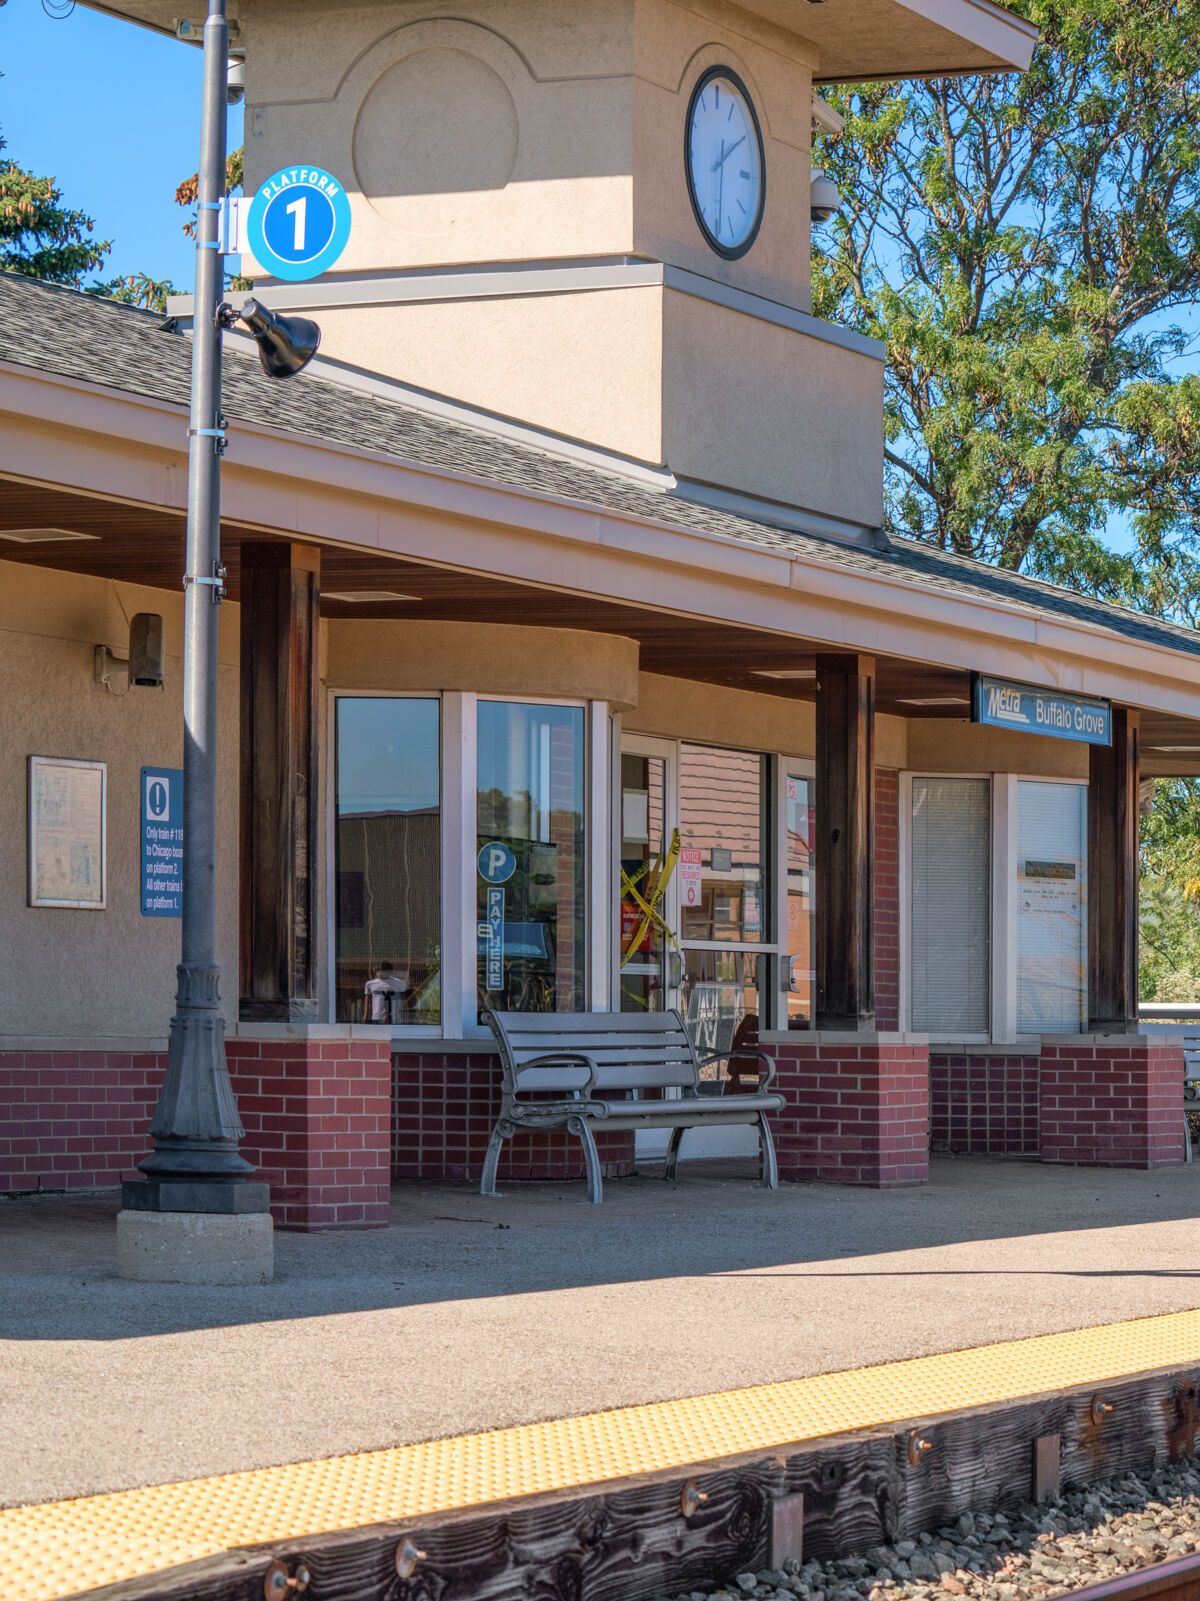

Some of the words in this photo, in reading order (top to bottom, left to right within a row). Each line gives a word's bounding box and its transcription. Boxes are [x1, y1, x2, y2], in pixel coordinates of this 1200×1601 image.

[261, 169, 339, 200] PLATFORM
[286, 196, 307, 251] 1
[988, 687, 1021, 718] Metra
[1036, 698, 1072, 729] Buffalo
[1074, 706, 1104, 735] Grove
[146, 826, 158, 842] Only
[159, 828, 170, 840] train
[146, 845, 152, 856] to
[152, 844, 172, 860] Chicago
[488, 849, 507, 877] P
[682, 850, 700, 863] NOTICE
[146, 864, 153, 873] on
[154, 862, 174, 876] platform
[154, 879, 166, 891] other
[166, 880, 180, 892] trains
[146, 898, 153, 908] on
[153, 896, 174, 911] platform
[490, 892, 501, 930] PAY
[489, 936, 501, 986] HERE
